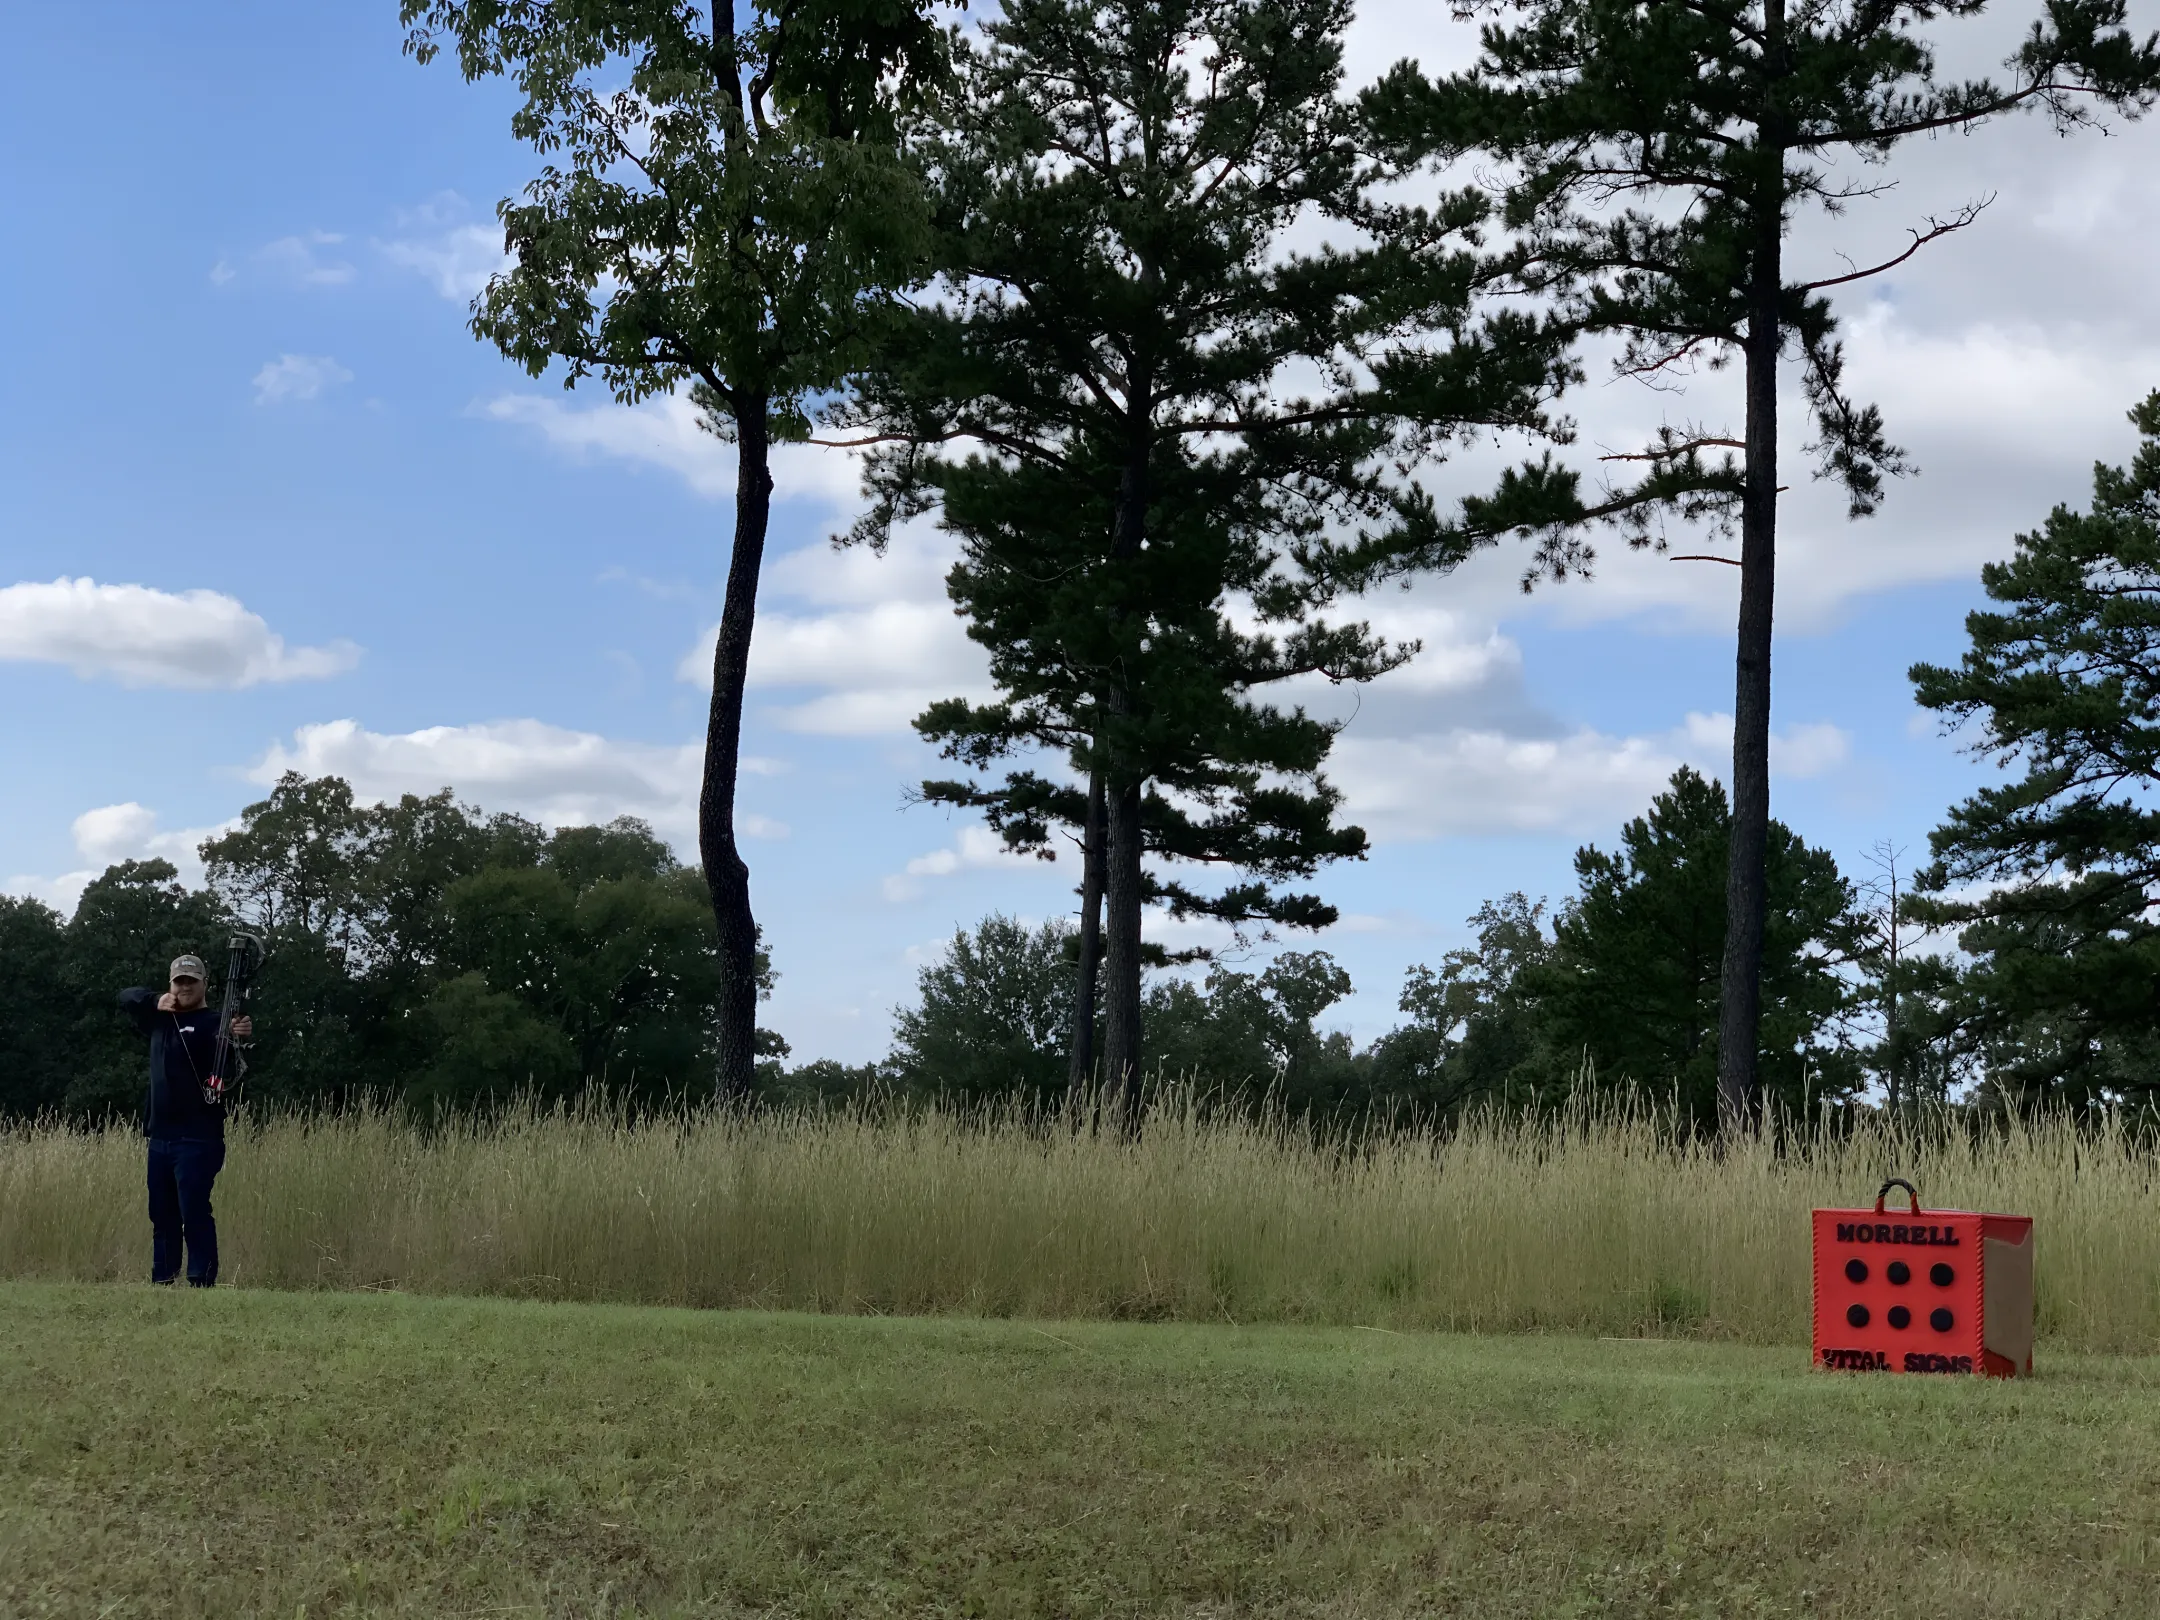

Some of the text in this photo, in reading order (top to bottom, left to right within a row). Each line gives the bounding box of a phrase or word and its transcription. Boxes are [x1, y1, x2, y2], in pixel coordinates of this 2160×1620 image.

[1837, 1223, 1959, 1246] MORRELL
[1821, 1348, 1972, 1373] VITAL SIGNS
